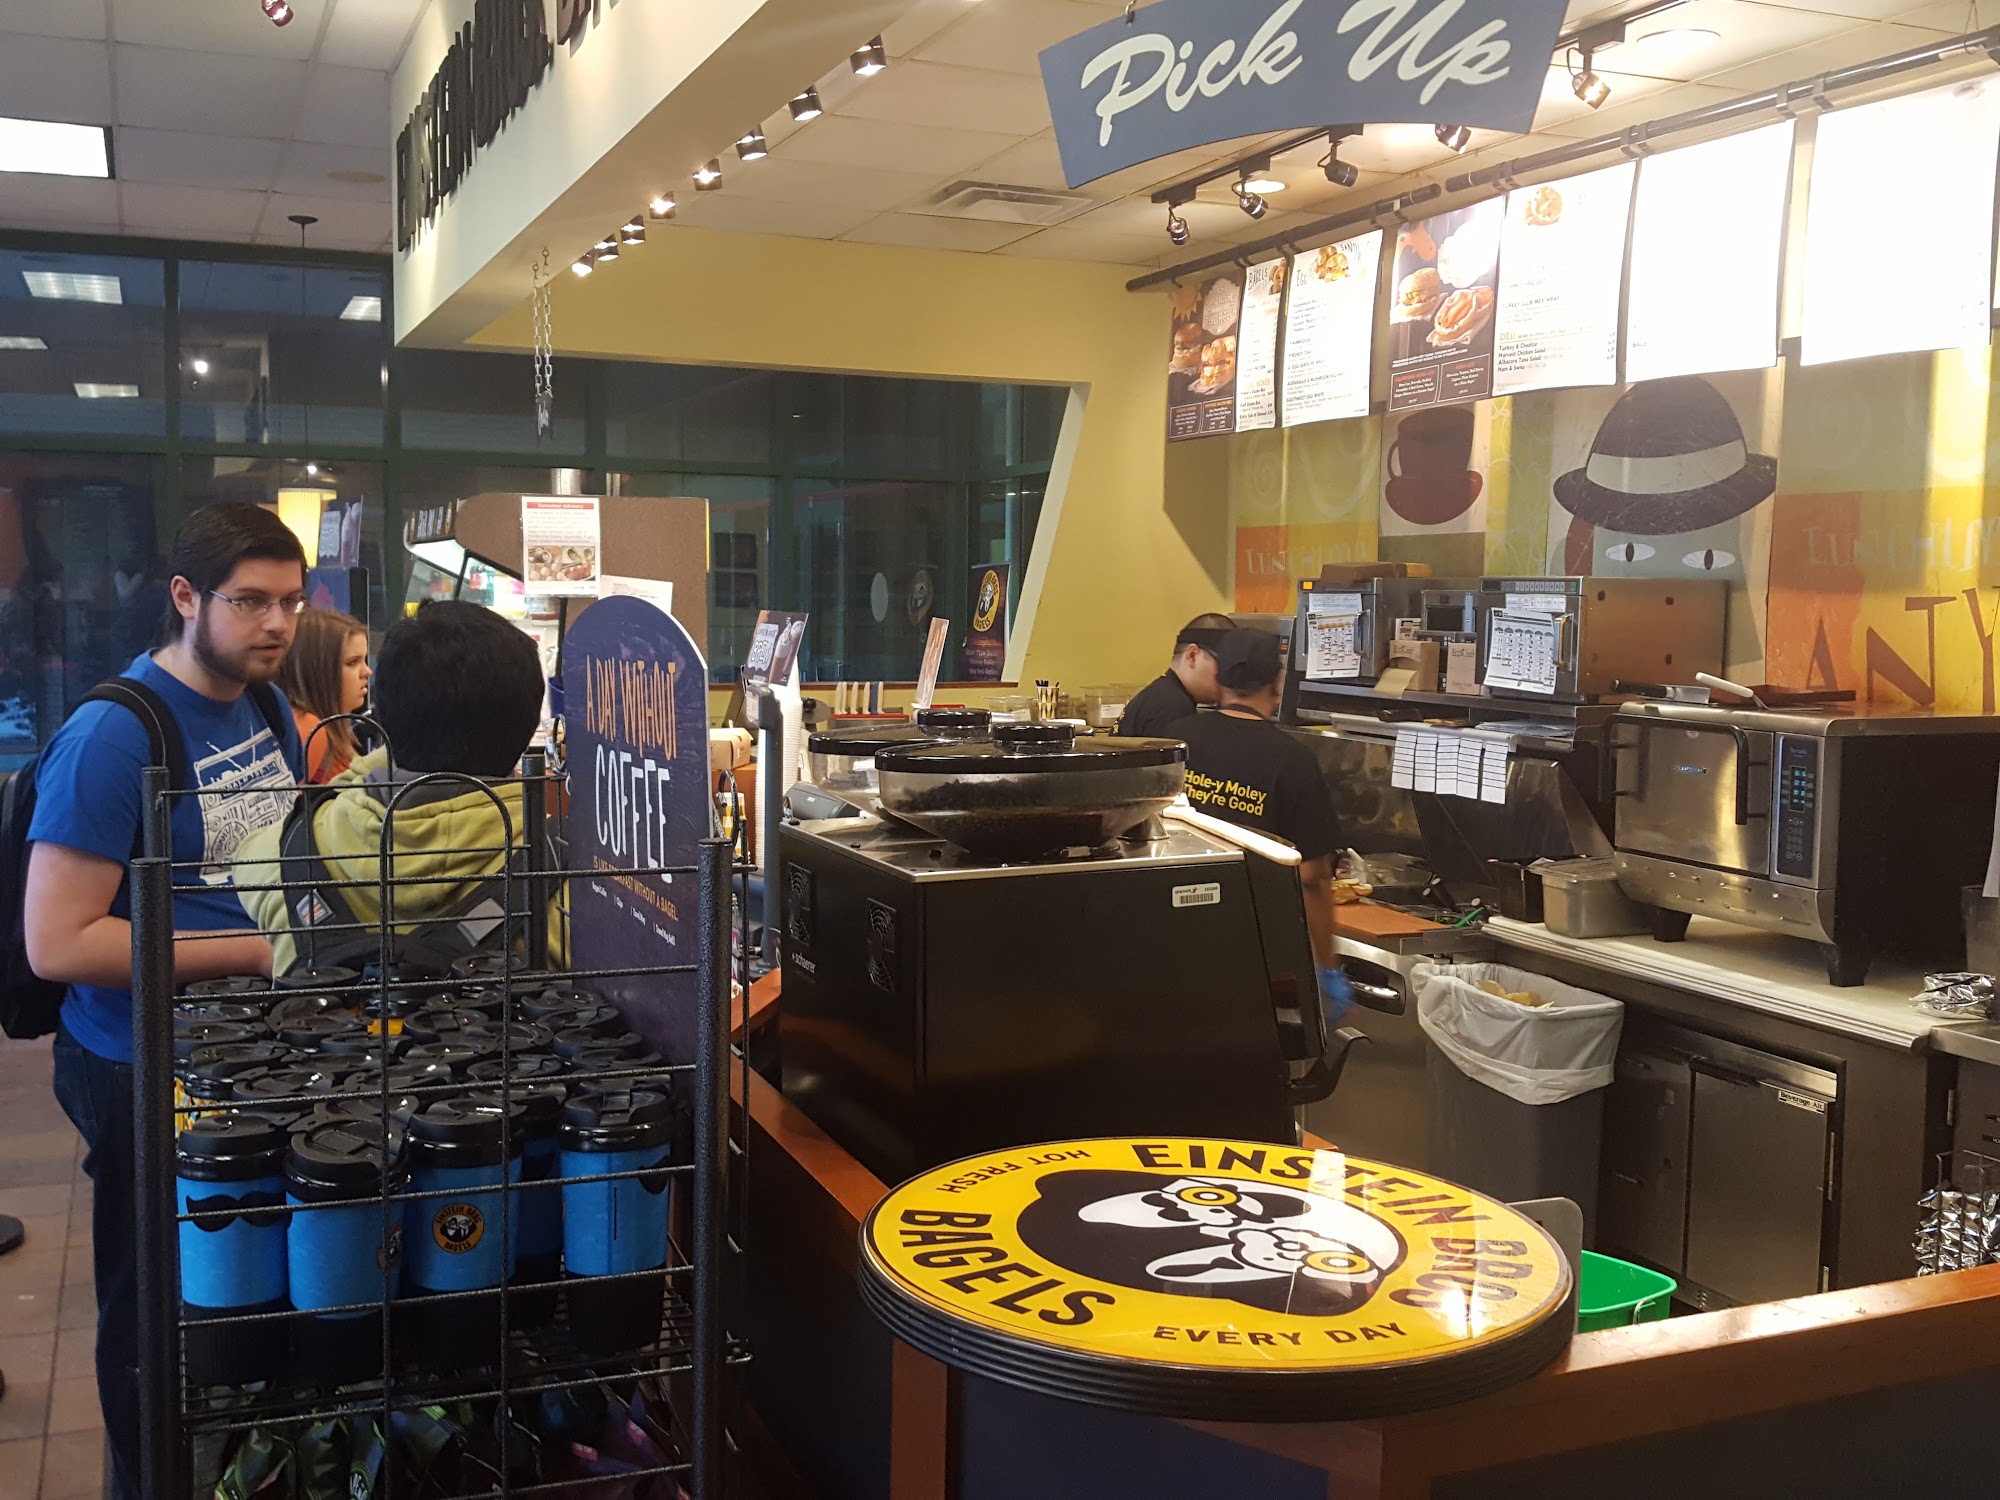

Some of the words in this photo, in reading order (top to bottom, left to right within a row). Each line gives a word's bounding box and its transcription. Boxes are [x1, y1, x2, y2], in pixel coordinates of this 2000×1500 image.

[1082, 0, 1302, 148] Pick
[1337, 0, 1510, 105] Up
[1248, 267, 1268, 290] BAGELS
[587, 654, 595, 735] A
[596, 656, 617, 743] DAY
[619, 659, 676, 761] WITHOUT
[1184, 769, 1224, 793] Hole-y
[1225, 780, 1268, 804] Moley
[1184, 784, 1226, 806] They're
[1228, 796, 1264, 816] Good
[595, 743, 672, 884] COFFEE
[634, 881, 657, 907] WITHOUT
[1027, 1150, 1092, 1165] HOT
[936, 1162, 1023, 1193] FRESH
[1130, 1143, 1493, 1227] EINSTEIN
[899, 1208, 1117, 1327] BAGELS
[1153, 1325, 1303, 1347] EVERY
[1328, 1322, 1409, 1345] DAY
